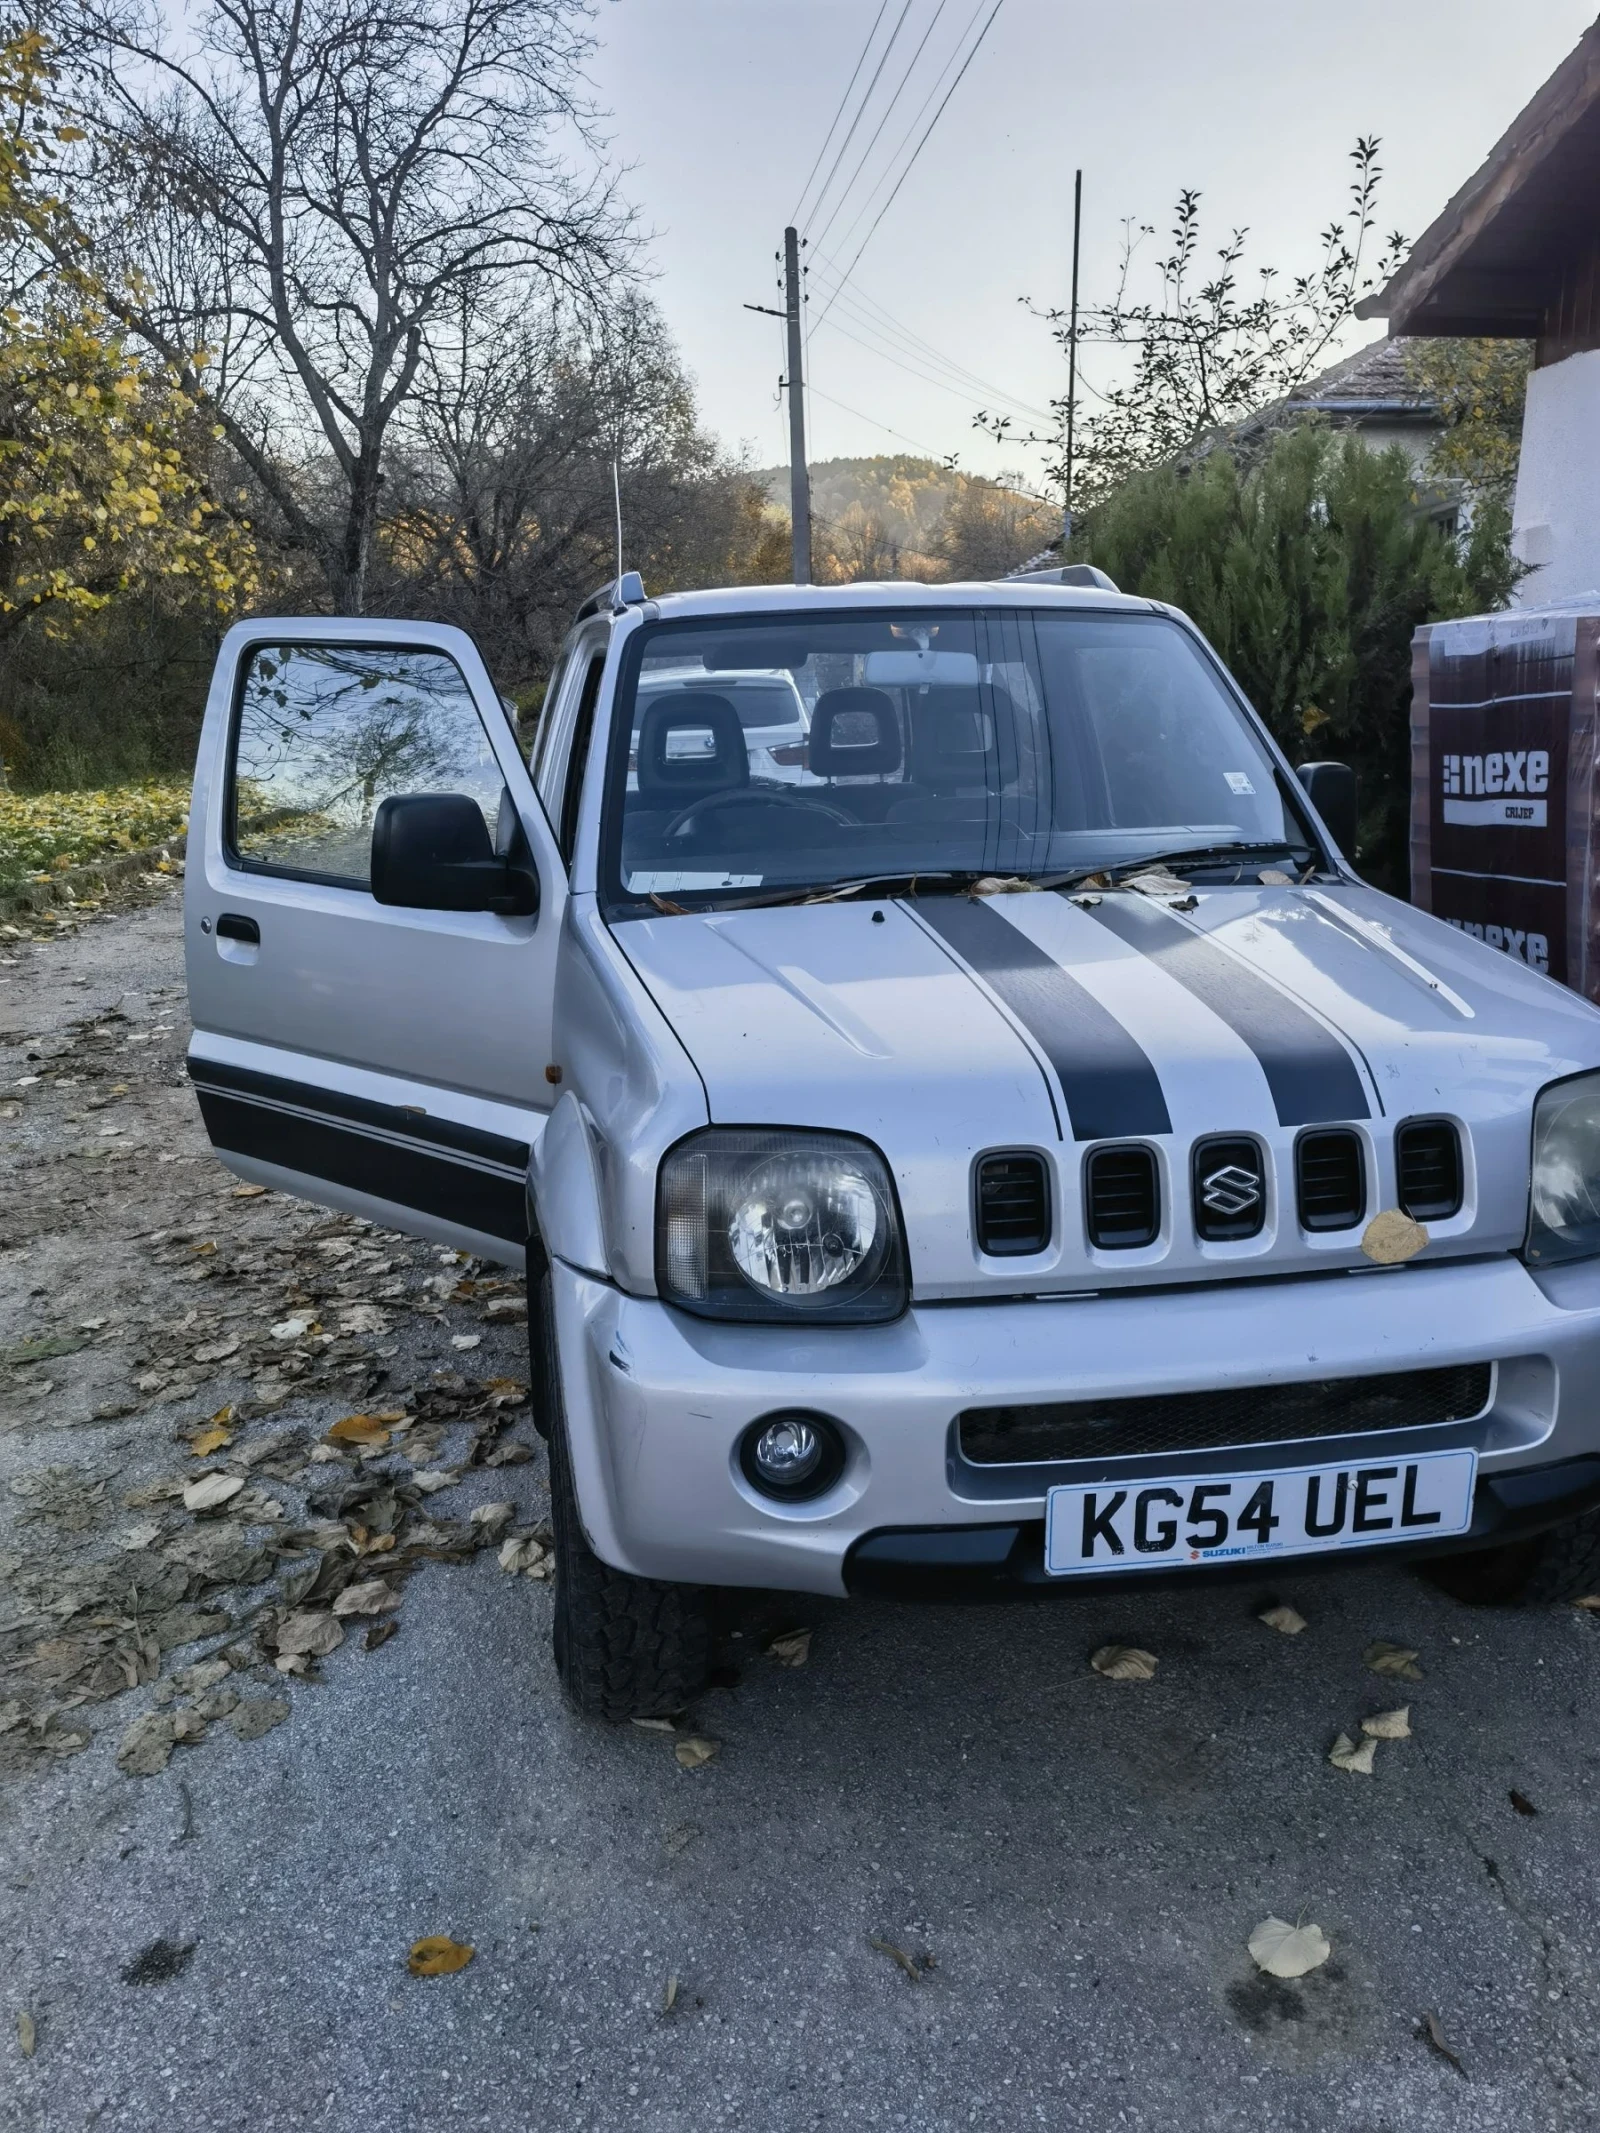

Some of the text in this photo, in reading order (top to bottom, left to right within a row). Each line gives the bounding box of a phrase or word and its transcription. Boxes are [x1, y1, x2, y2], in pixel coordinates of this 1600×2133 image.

[1463, 751, 1549, 795] nexe
[1505, 806, 1534, 819] CRIJEP
[1081, 1465, 1441, 1558] KG54 UEL
[1202, 1547, 1246, 1558] SUZUKI
